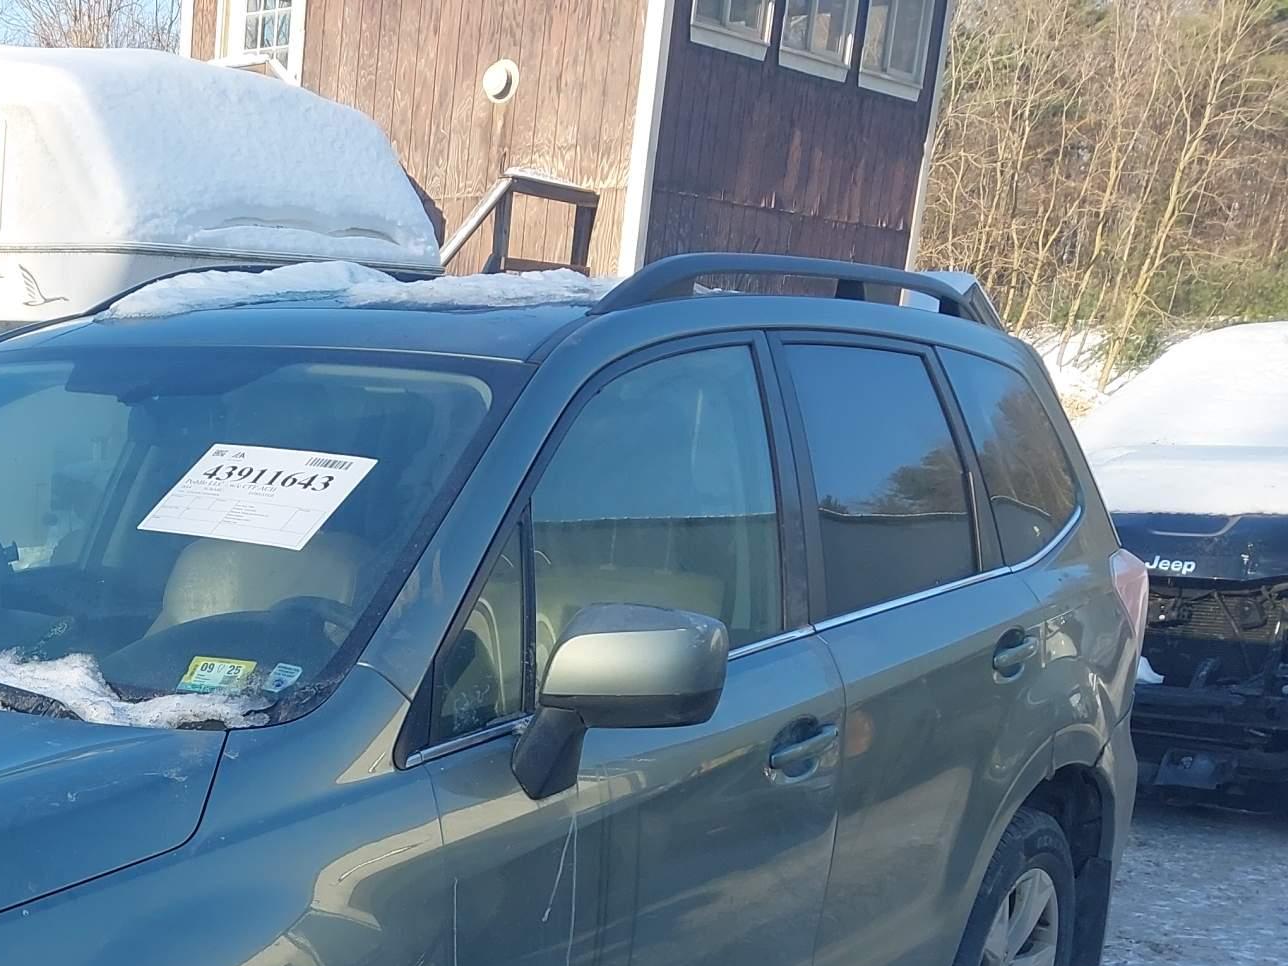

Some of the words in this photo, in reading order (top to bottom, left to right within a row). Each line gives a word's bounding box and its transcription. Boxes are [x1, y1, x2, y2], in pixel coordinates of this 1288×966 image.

[202, 464, 335, 492] 43911643
[1144, 555, 1196, 575] Jeep
[200, 662, 215, 673] 09
[226, 665, 242, 675] 25
